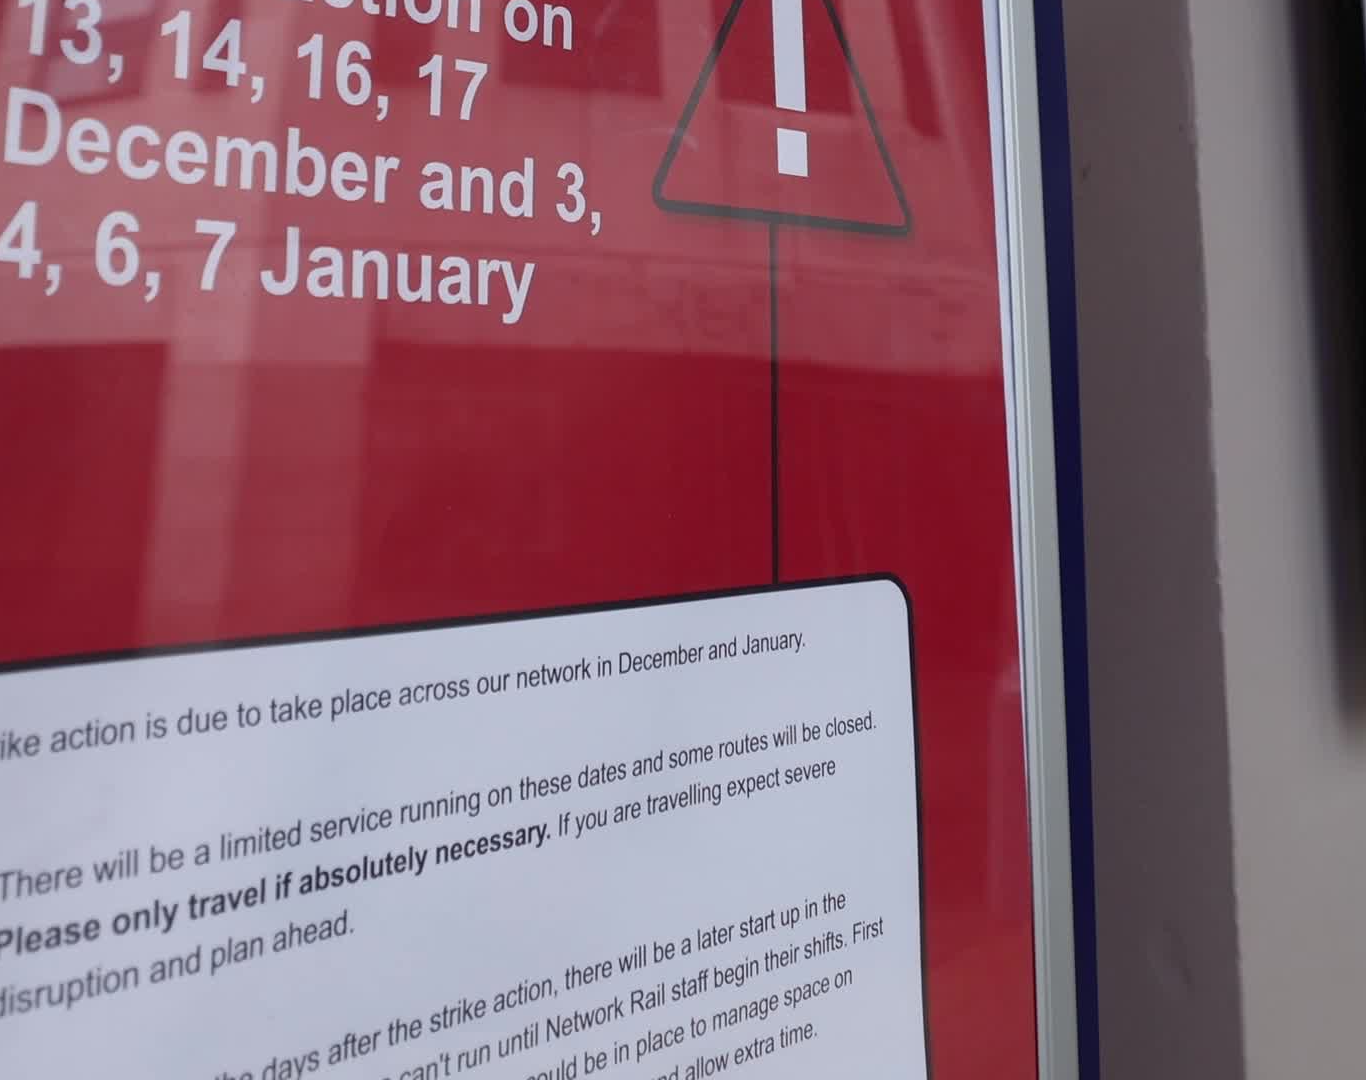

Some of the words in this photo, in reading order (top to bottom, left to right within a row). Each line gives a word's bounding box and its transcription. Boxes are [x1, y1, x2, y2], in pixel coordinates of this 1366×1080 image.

[160, 9, 265, 105] 14,
[296, 32, 390, 122] 16,
[418, 53, 489, 122] 17
[3, 84, 401, 204] December
[419, 156, 535, 219] and
[555, 161, 602, 237] 3,
[94, 209, 161, 304] 6,
[194, 218, 237, 292] 7
[259, 225, 536, 325] January
[50, 719, 136, 753] action
[145, 711, 168, 740] is
[176, 707, 228, 737] due
[236, 702, 262, 729] to
[269, 694, 323, 724] take
[330, 687, 392, 723] place
[398, 678, 471, 707] across
[476, 672, 511, 696] our
[516, 656, 592, 690] network
[597, 655, 613, 679] in
[618, 643, 705, 675] December
[708, 635, 738, 661] and
[741, 630, 806, 657] January.
[92, 848, 140, 884] will
[149, 844, 185, 874] be
[194, 843, 211, 867] a
[220, 818, 302, 862] limited
[309, 807, 393, 844] service
[399, 789, 481, 825] running
[487, 785, 513, 808] on
[518, 773, 573, 801] these
[577, 762, 627, 789] dates
[631, 749, 664, 778] and
[668, 744, 714, 770] some
[718, 733, 769, 760] routes
[771, 723, 798, 749] will
[801, 721, 821, 743] be
[825, 710, 877, 739] closed.
[111, 898, 180, 937] only
[187, 876, 267, 921] travel
[274, 870, 294, 902] if
[298, 844, 429, 896] absolutely
[435, 822, 552, 865] necessary.
[558, 811, 572, 838] If
[574, 808, 608, 840] you
[613, 801, 642, 824] are
[646, 781, 722, 816] travelling
[726, 767, 781, 800] expect
[784, 759, 836, 785] severe
[149, 944, 202, 985] and
[210, 936, 265, 977] plan
[271, 908, 355, 953] ahead.
[261, 1049, 321, 1080] days
[327, 1029, 382, 1066] after
[387, 1017, 423, 1047] the
[428, 997, 487, 1034] strike
[492, 977, 559, 1014] action,
[564, 960, 613, 991] there
[618, 943, 647, 974] will
[652, 940, 676, 964] be
[680, 937, 692, 956] a
[696, 924, 736, 952] later
[739, 908, 776, 939] start
[780, 906, 801, 930] up
[804, 898, 819, 920] in
[822, 891, 847, 915] the
[457, 1044, 491, 1073] run
[498, 1021, 539, 1059] until
[546, 995, 625, 1043] Network
[630, 981, 666, 1016] Rail
[671, 967, 710, 1002] staff
[713, 955, 760, 989] begin
[763, 943, 801, 973] their
[803, 930, 848, 960] shifts.
[852, 915, 884, 945] First
[583, 1050, 608, 1076] be
[613, 1040, 630, 1065] in
[636, 1025, 685, 1064] place
[689, 1016, 707, 1039] to
[712, 994, 780, 1032] manage
[783, 976, 831, 1009] space
[834, 968, 853, 990] on
[684, 1052, 730, 1080] allow
[733, 1036, 775, 1066] extra
[779, 1022, 818, 1049] time.
